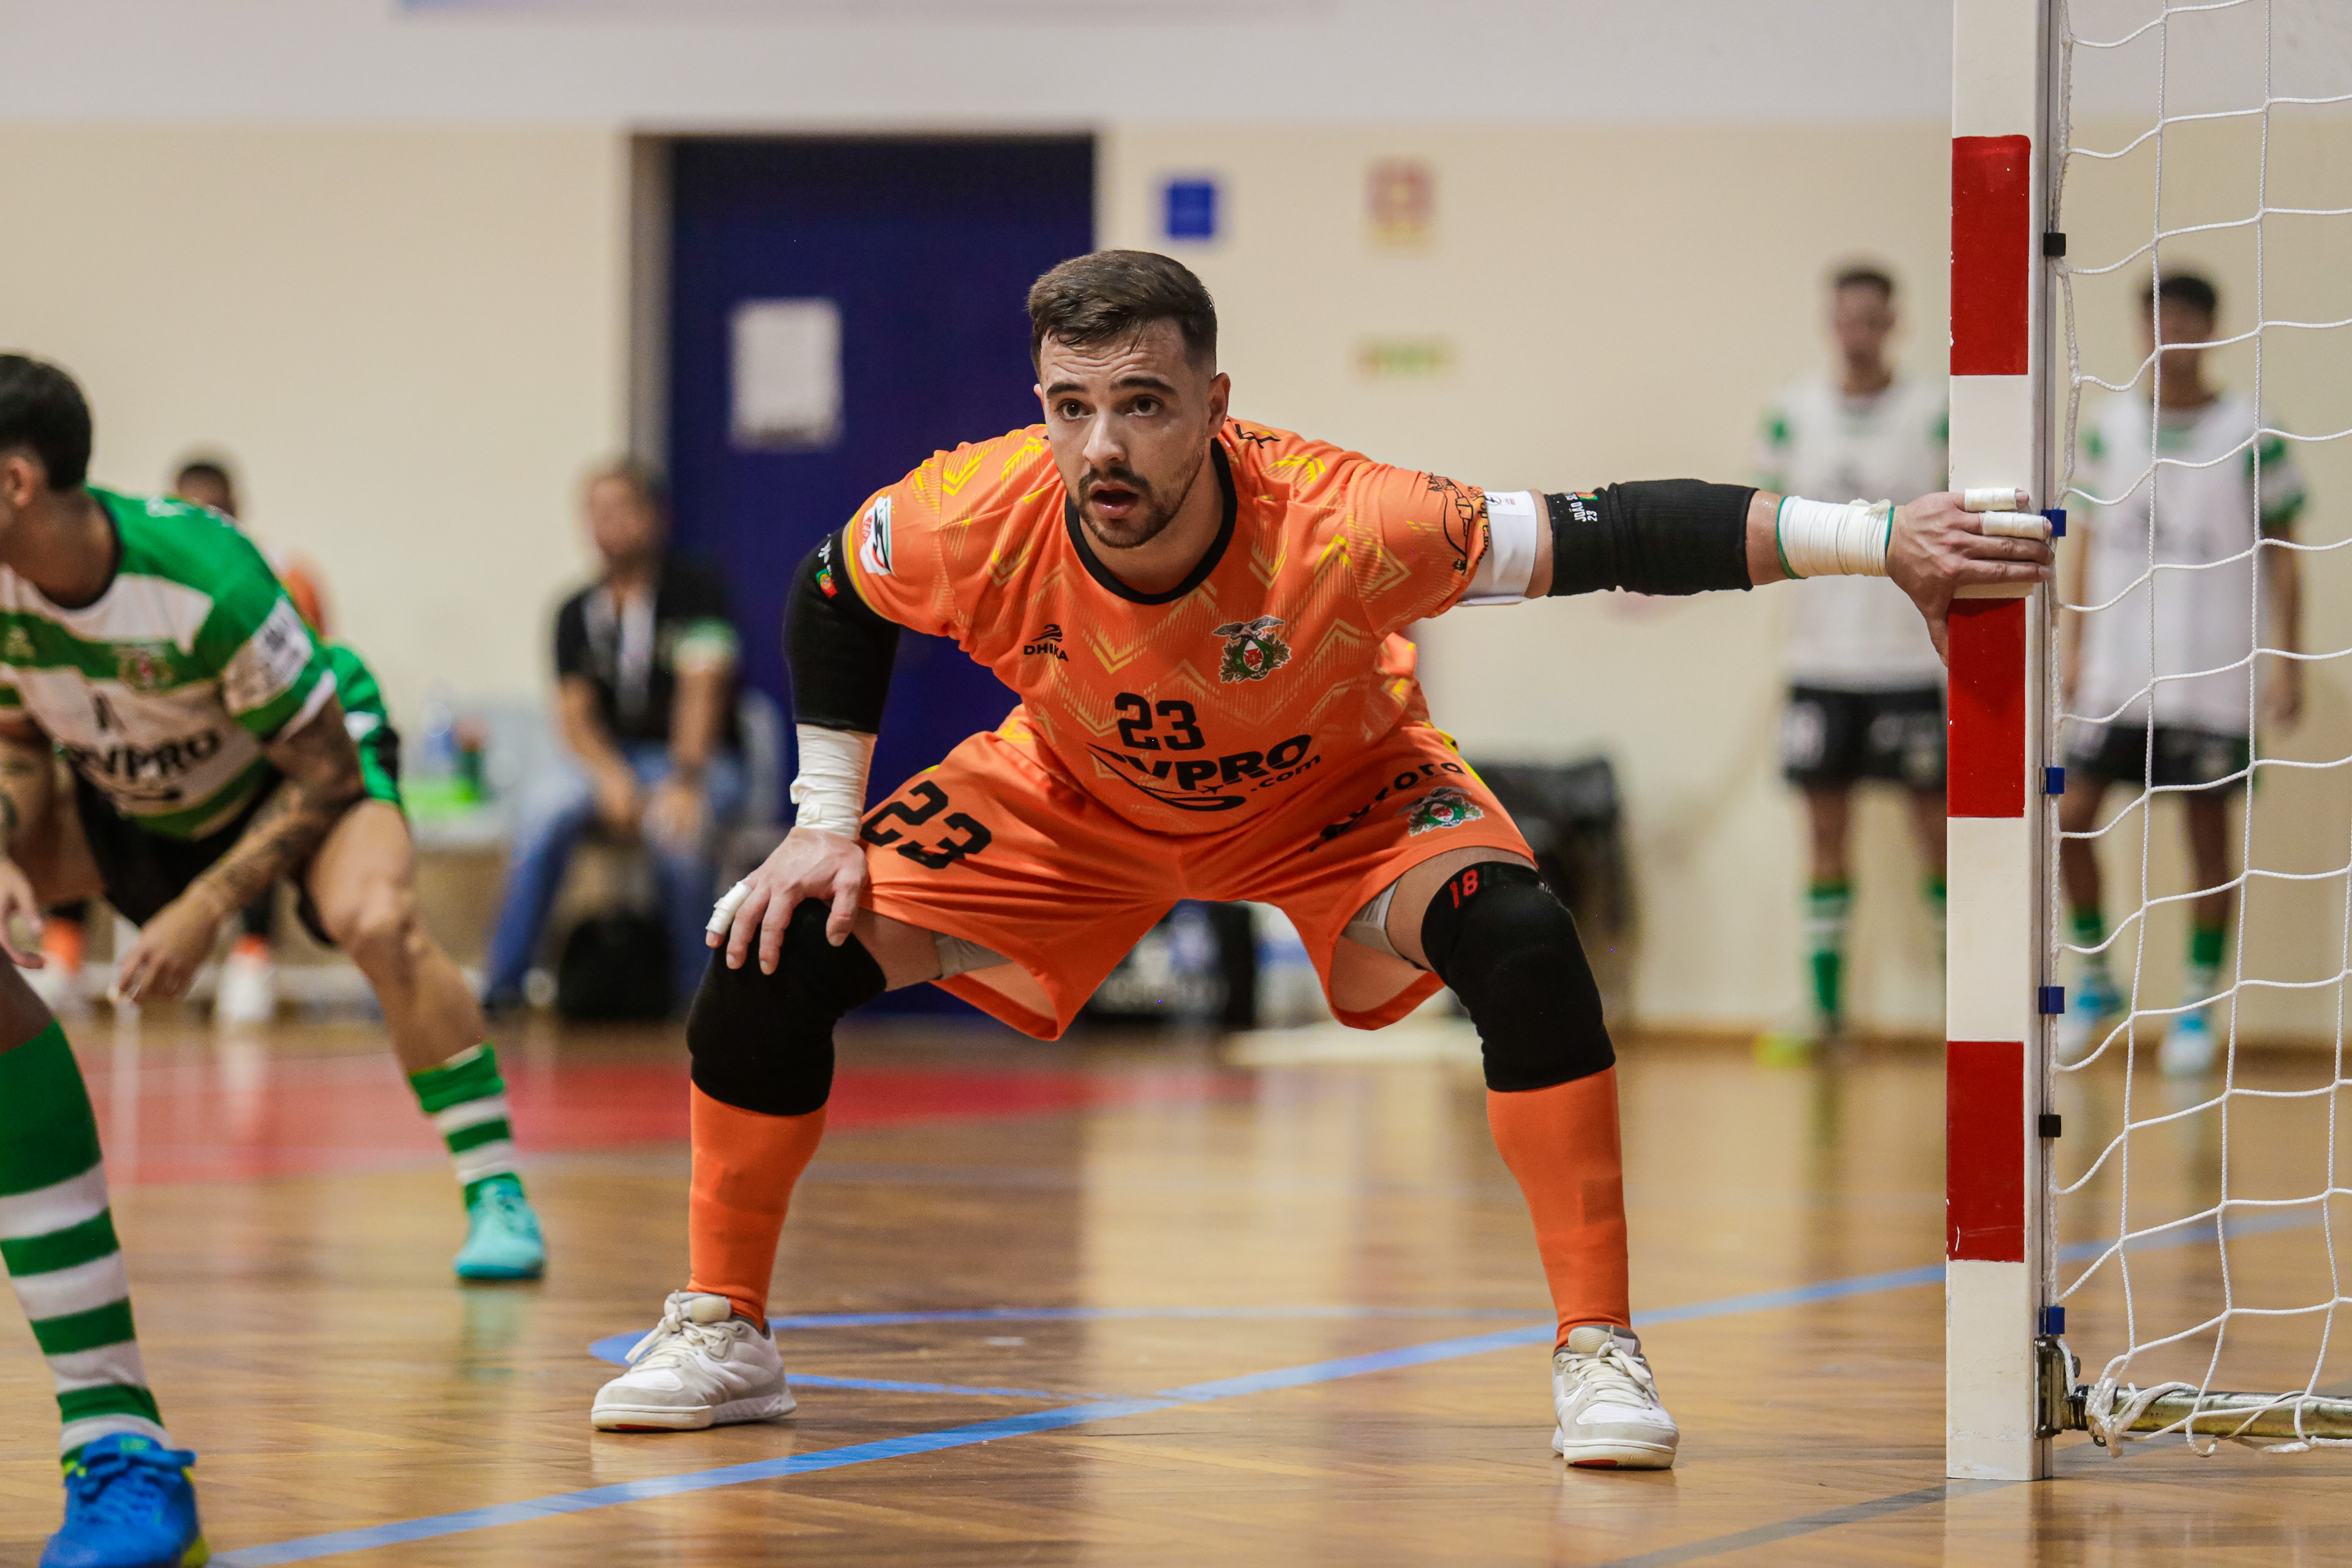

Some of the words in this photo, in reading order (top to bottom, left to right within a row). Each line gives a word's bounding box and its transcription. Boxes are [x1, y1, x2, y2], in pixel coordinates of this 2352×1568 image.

[1585, 510, 1598, 522] 23
[1023, 643, 1069, 662] DHIKA
[1114, 692, 1205, 751] 23
[1250, 755, 1321, 792] .com
[859, 780, 992, 870] 23
[1449, 869, 1479, 909] 18
